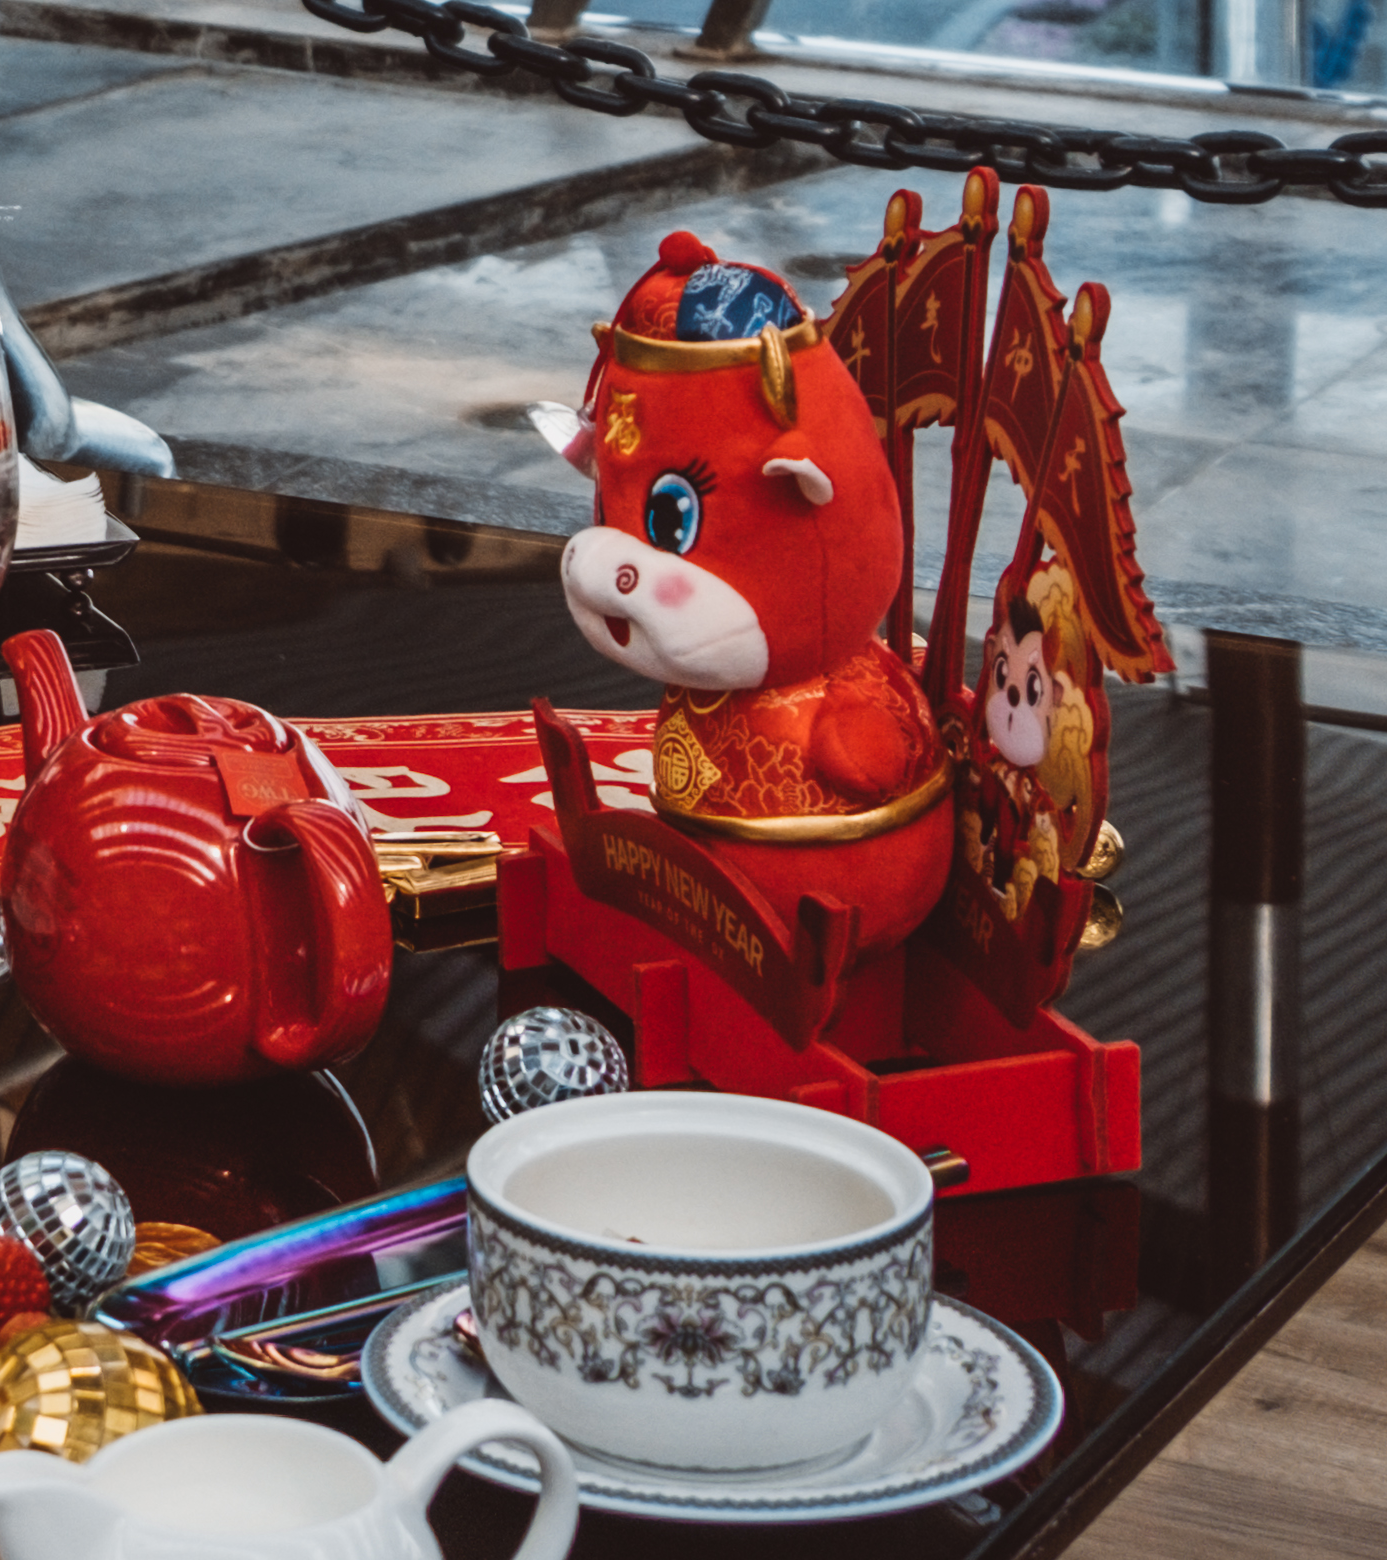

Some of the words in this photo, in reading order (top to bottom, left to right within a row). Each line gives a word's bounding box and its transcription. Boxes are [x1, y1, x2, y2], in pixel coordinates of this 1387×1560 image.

[602, 832, 663, 887] HAPPY
[664, 857, 710, 921] NEW
[712, 894, 765, 978] YEAR
[637, 890, 664, 915] YEAR
